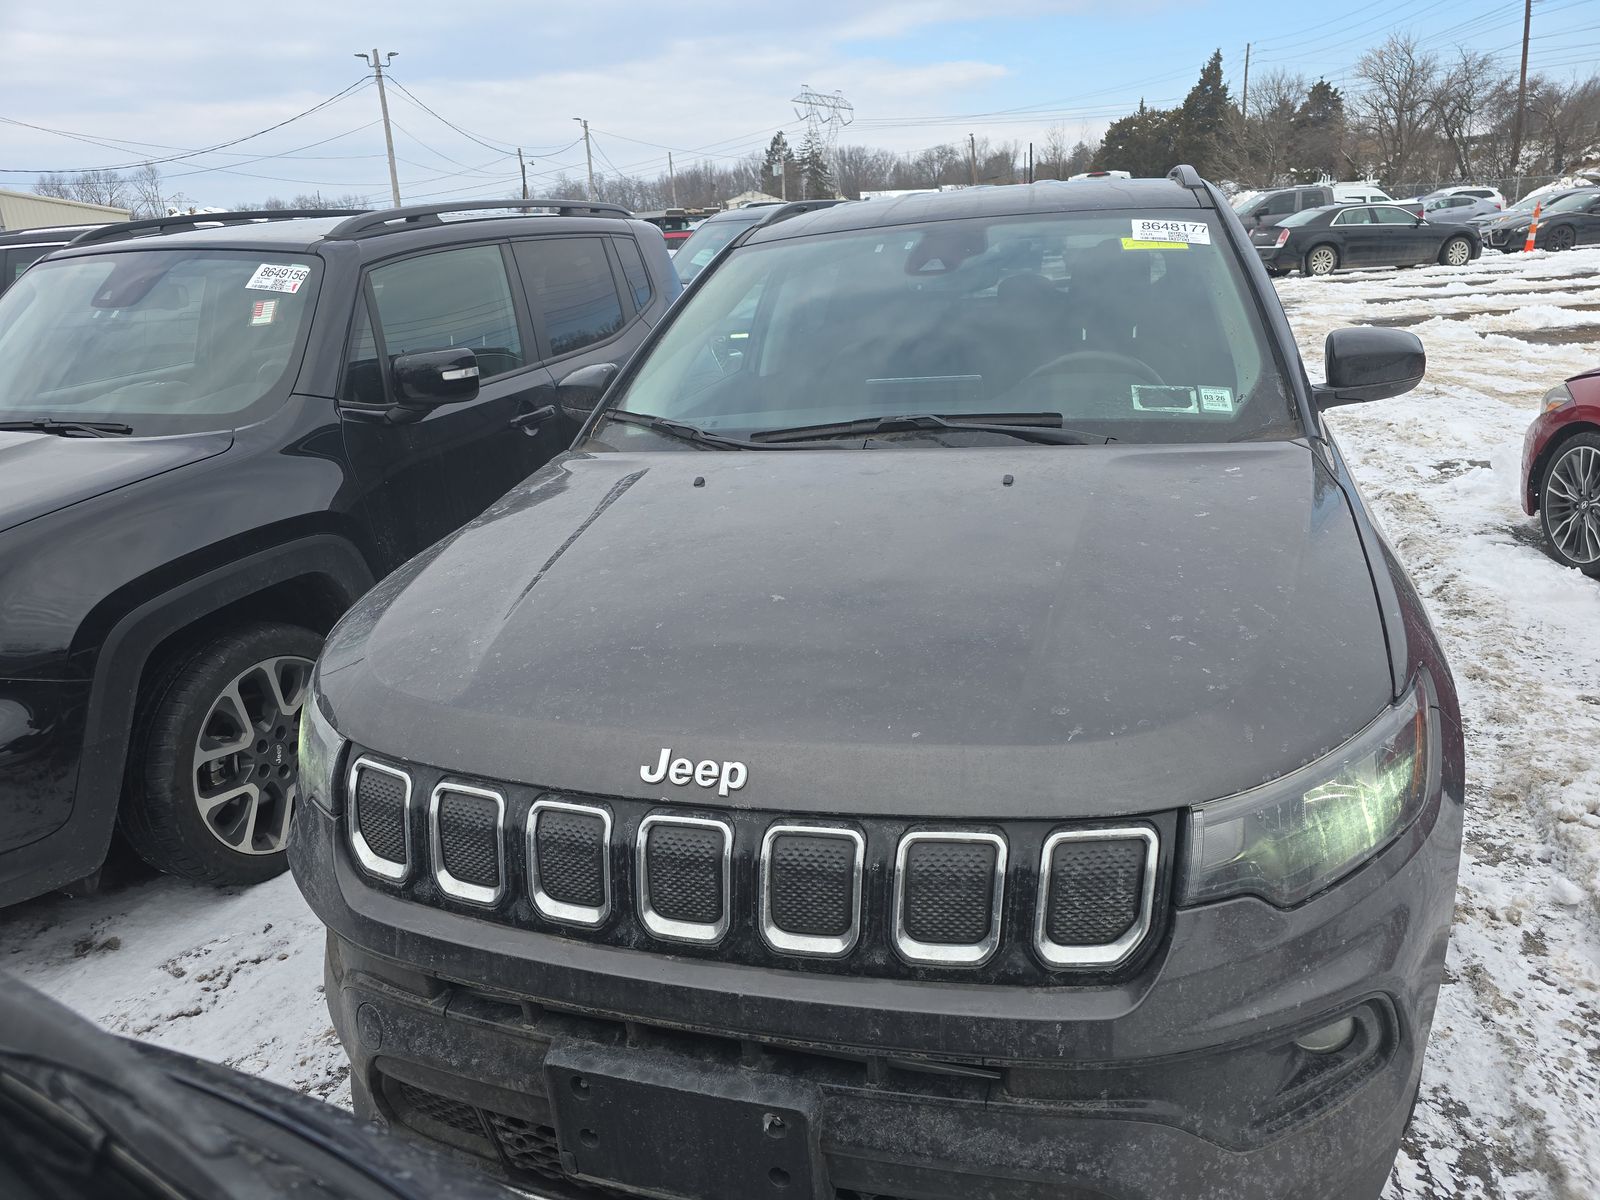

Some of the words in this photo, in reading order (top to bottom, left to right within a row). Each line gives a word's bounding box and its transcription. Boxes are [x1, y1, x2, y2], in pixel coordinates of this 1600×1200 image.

[1141, 221, 1207, 233] 8648177
[260, 267, 308, 281] 8649156
[275, 744, 283, 764] Jeep
[640, 748, 748, 797] Jeep
